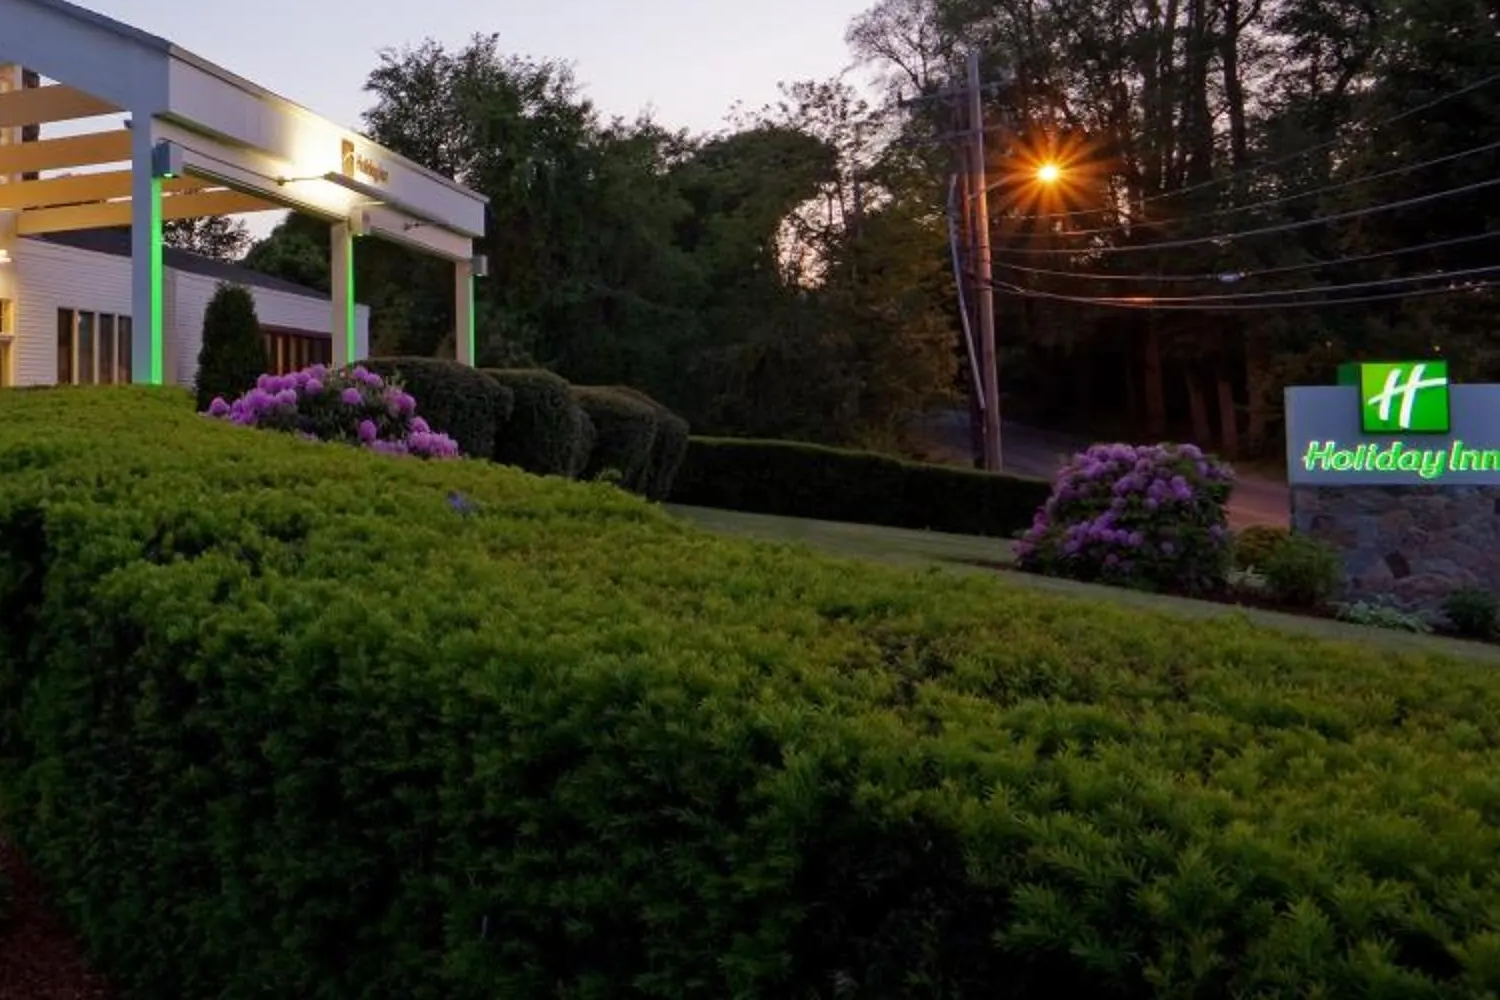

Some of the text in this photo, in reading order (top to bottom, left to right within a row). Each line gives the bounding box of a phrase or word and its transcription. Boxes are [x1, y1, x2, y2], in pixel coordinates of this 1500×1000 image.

[1368, 363, 1447, 429] H
[1302, 440, 1500, 480] Holiday Inn
